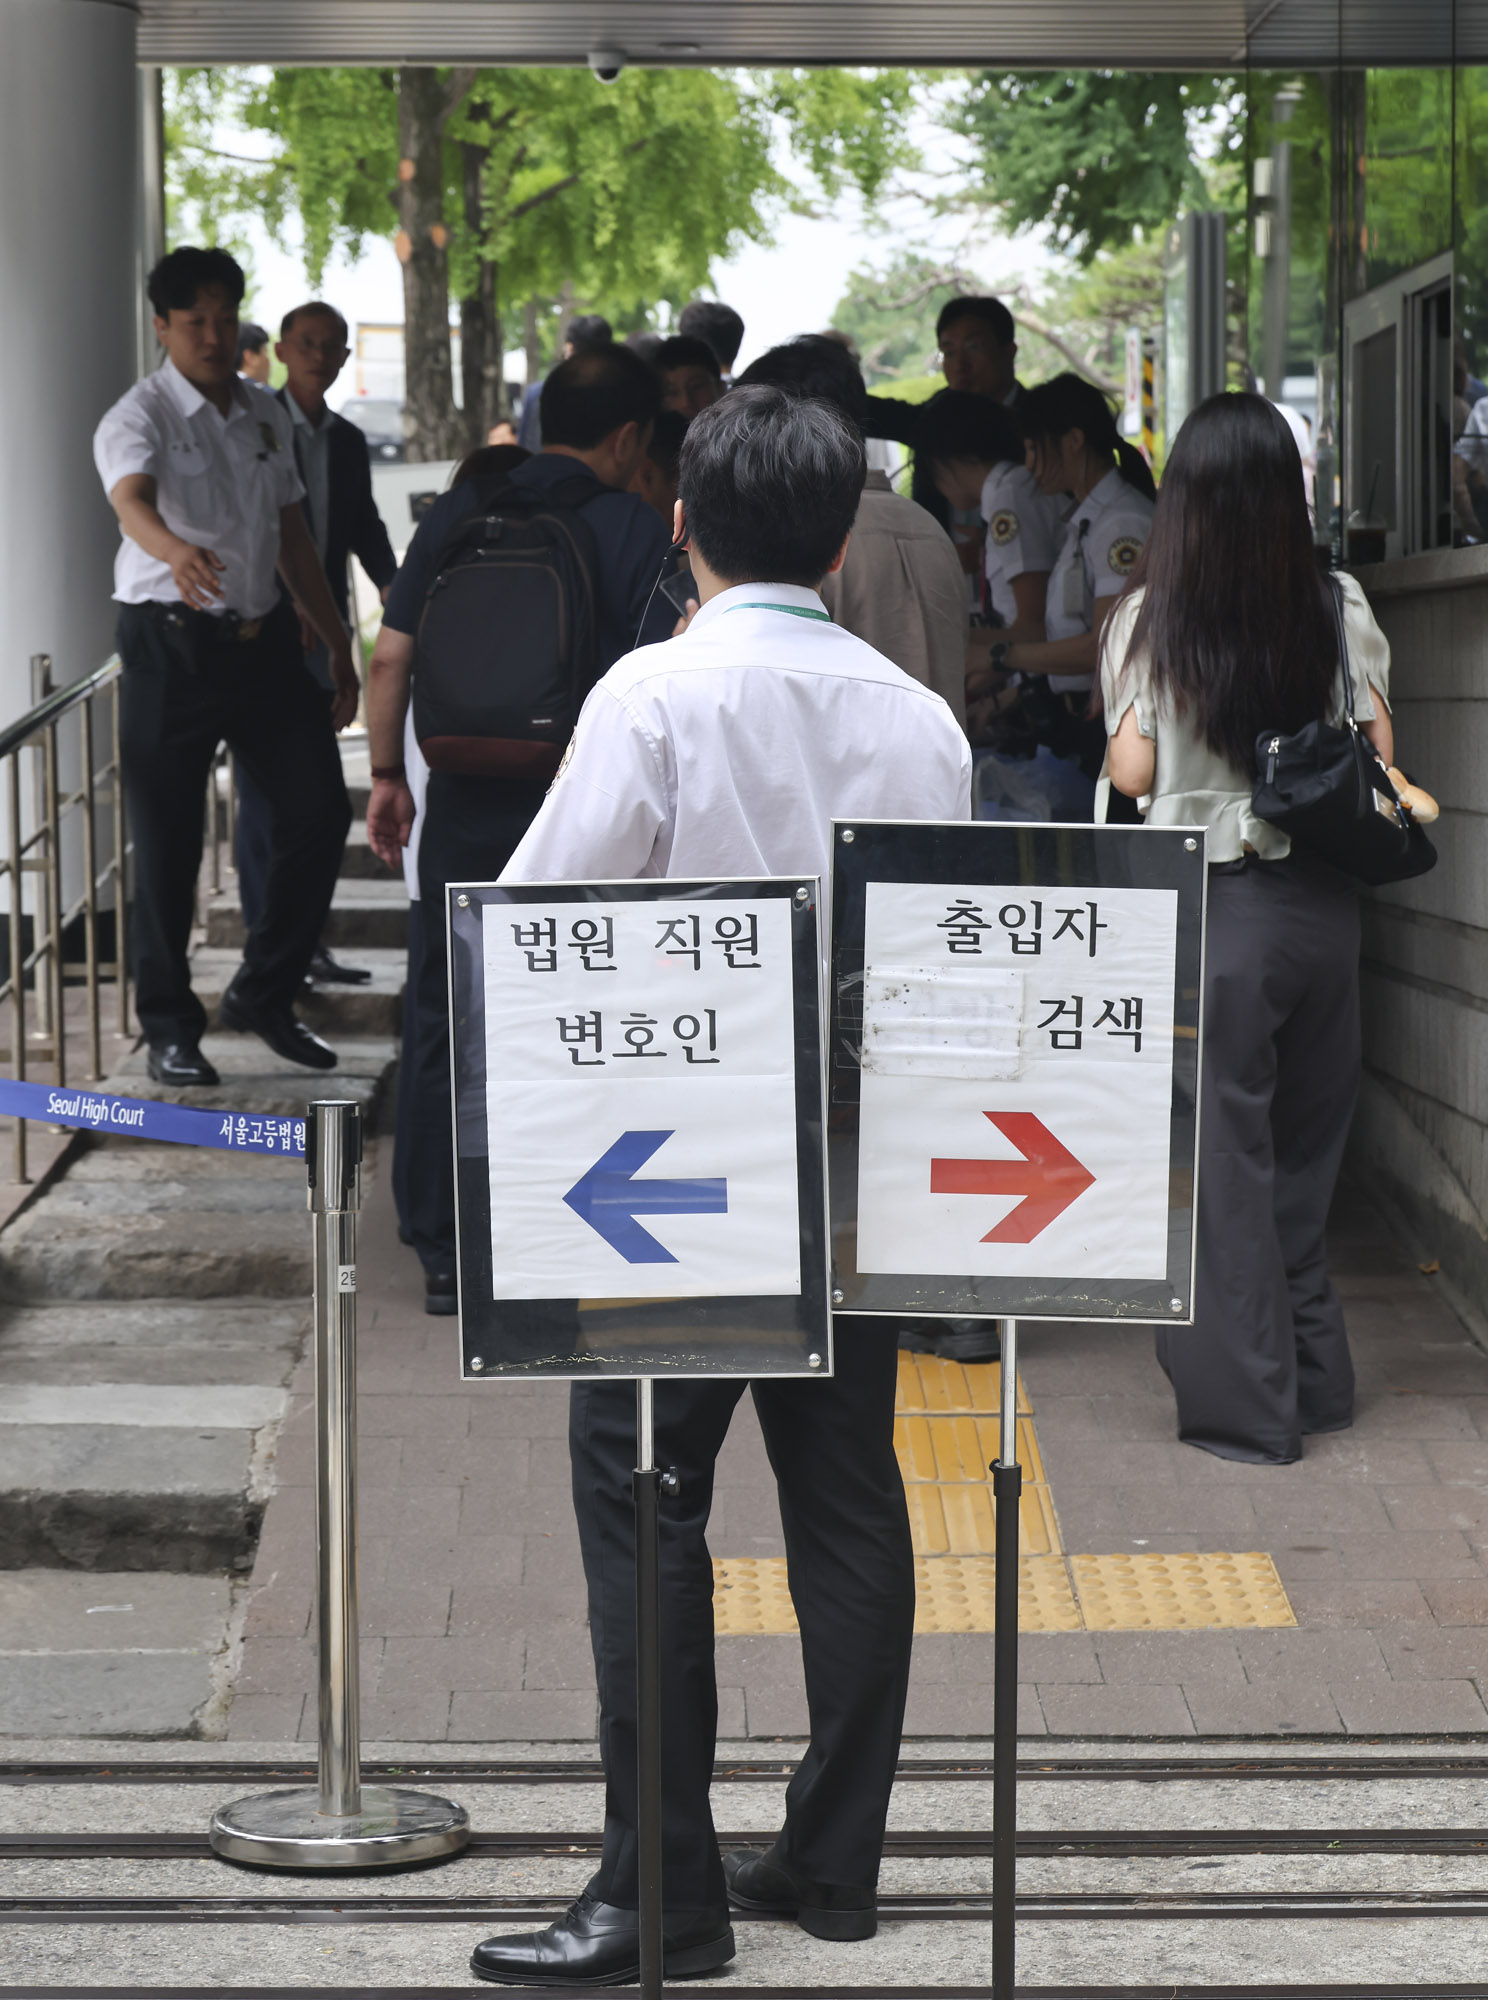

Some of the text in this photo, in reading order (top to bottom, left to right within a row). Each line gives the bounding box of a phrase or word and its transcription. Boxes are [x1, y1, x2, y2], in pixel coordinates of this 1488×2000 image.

[510, 913, 762, 972] 법원 직원
[937, 899, 1108, 958] 출입자
[556, 1008, 721, 1066] 변호인
[1037, 995, 1143, 1053] 검색
[46, 1092, 145, 1127] Seoul High Court
[219, 1115, 306, 1151] 서울고등법원
